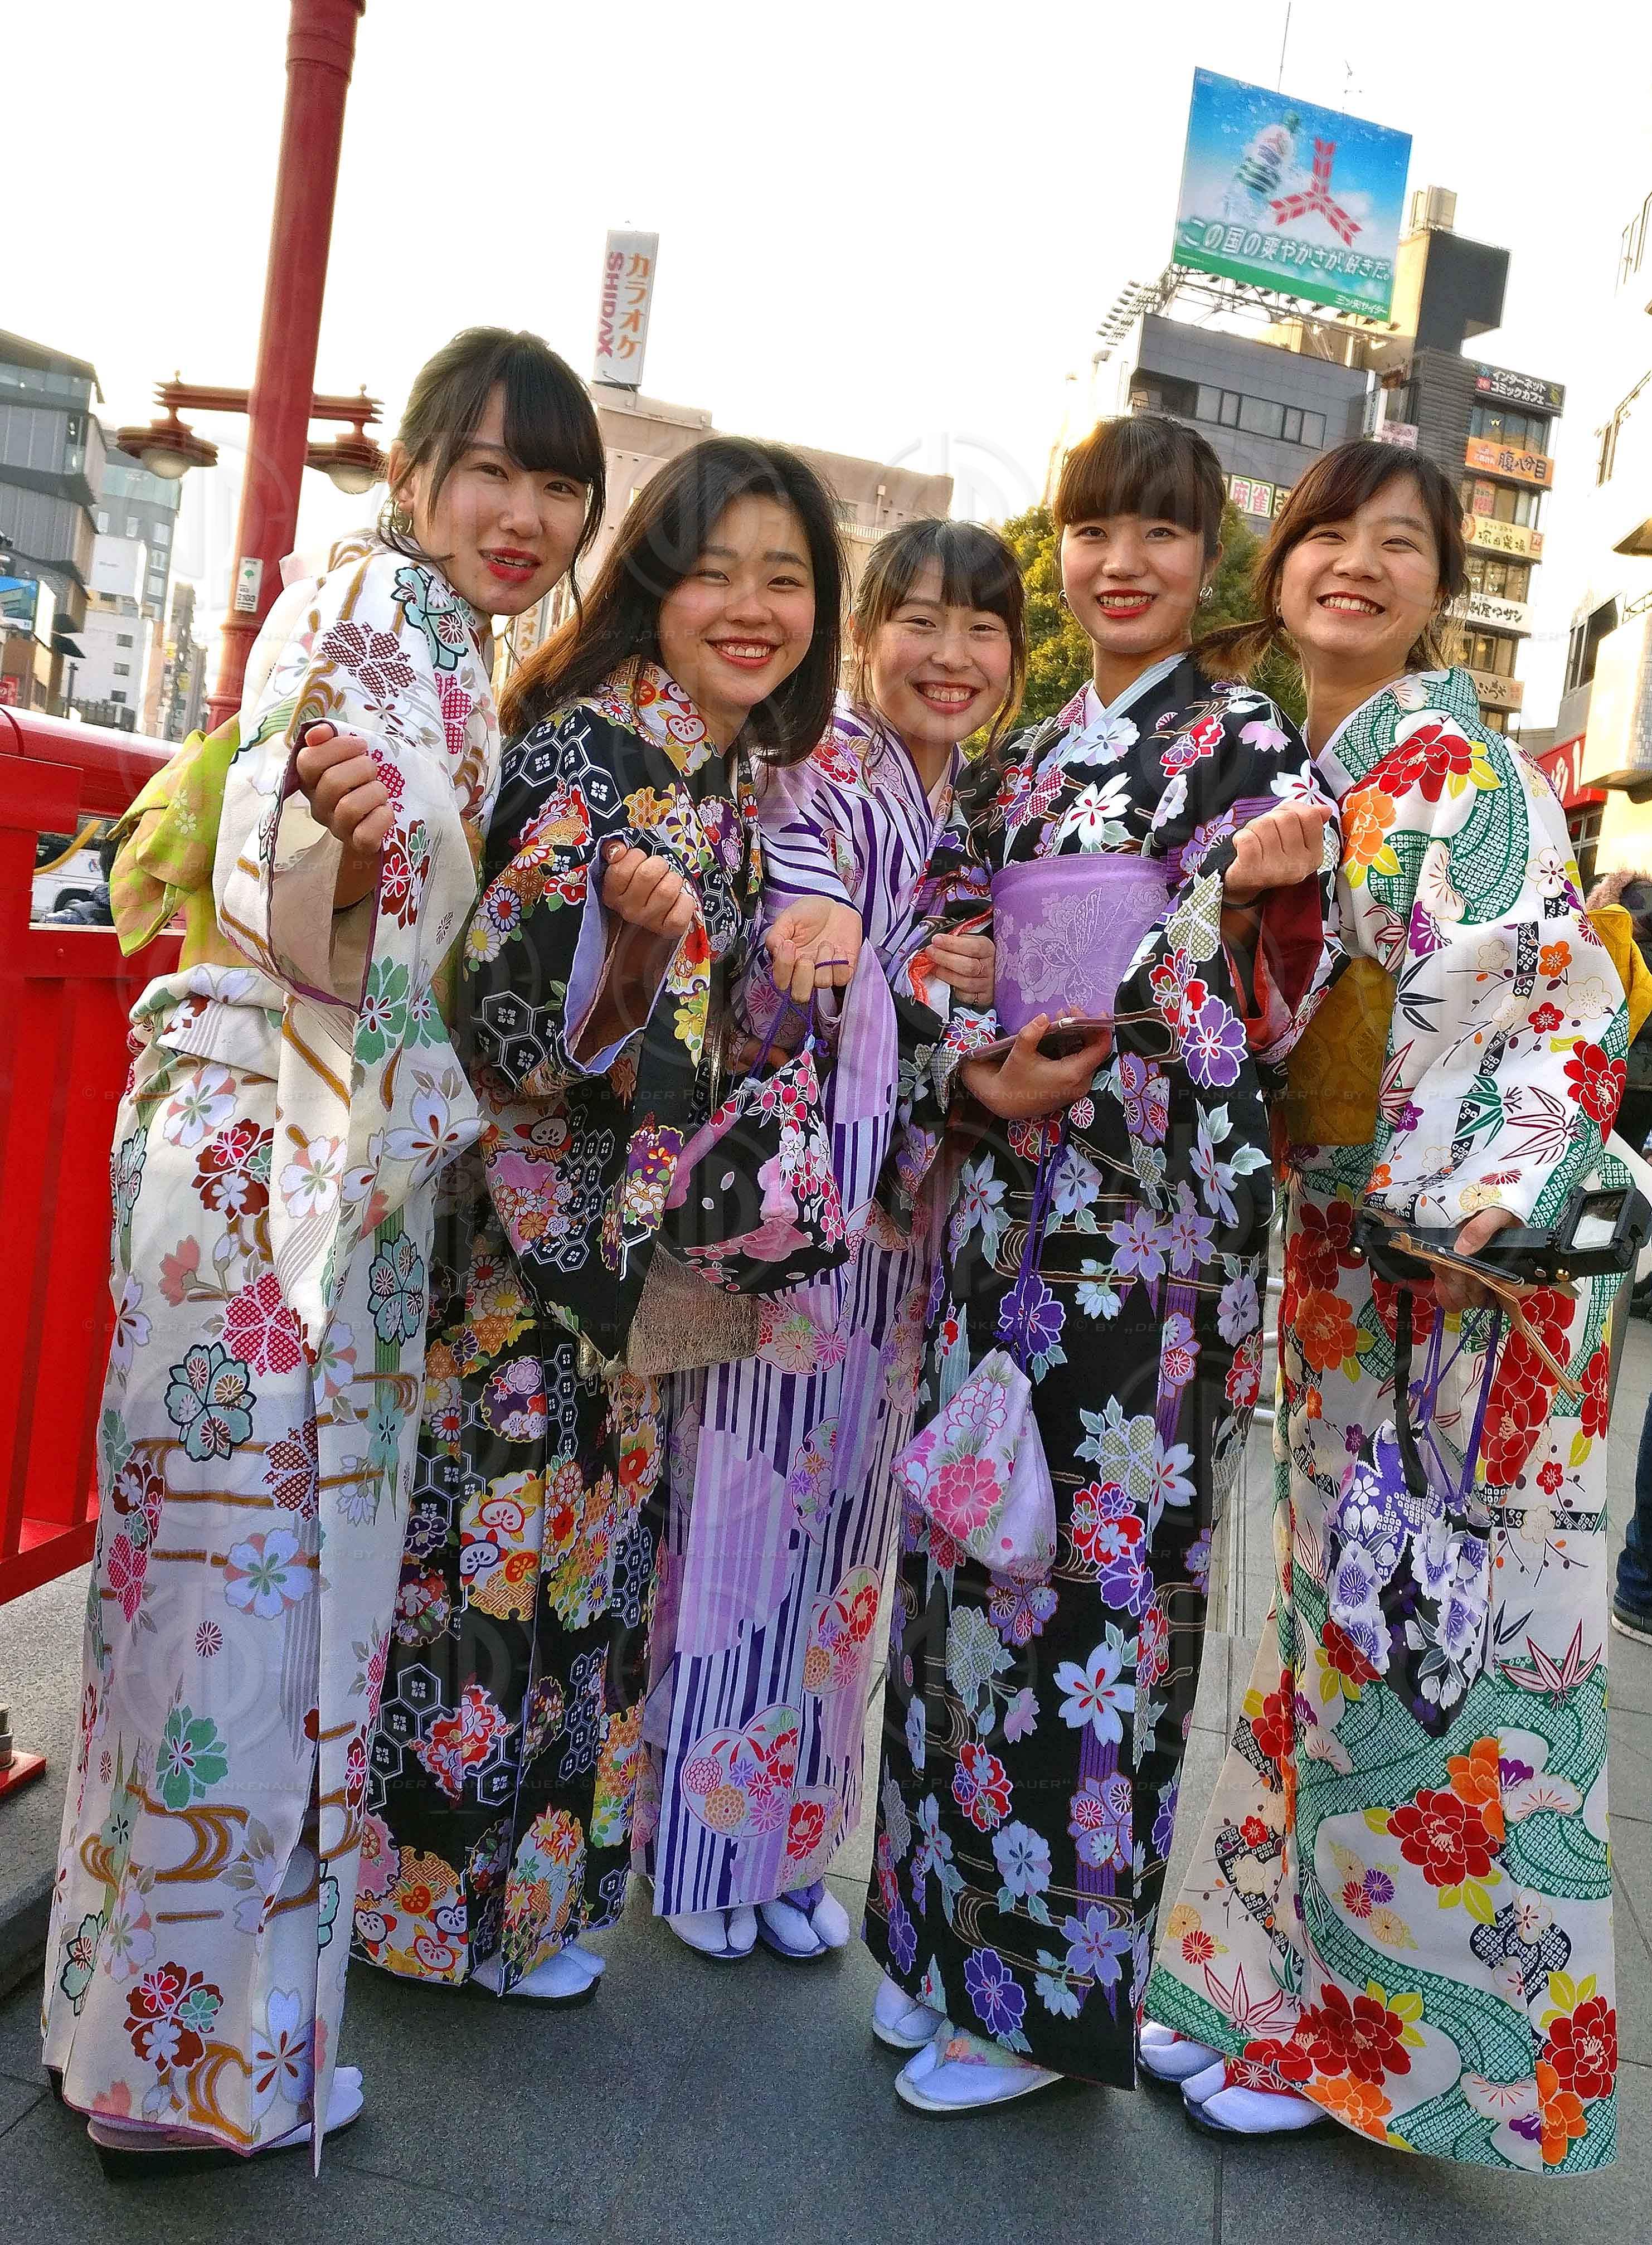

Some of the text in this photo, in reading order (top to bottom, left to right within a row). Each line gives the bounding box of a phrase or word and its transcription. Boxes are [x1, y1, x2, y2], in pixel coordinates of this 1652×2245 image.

[597, 252, 625, 358] SHIDAX
[616, 253, 650, 359] カラオケ
[1493, 371, 1546, 393] インターネット
[1498, 450, 1547, 479] 腹八分目
